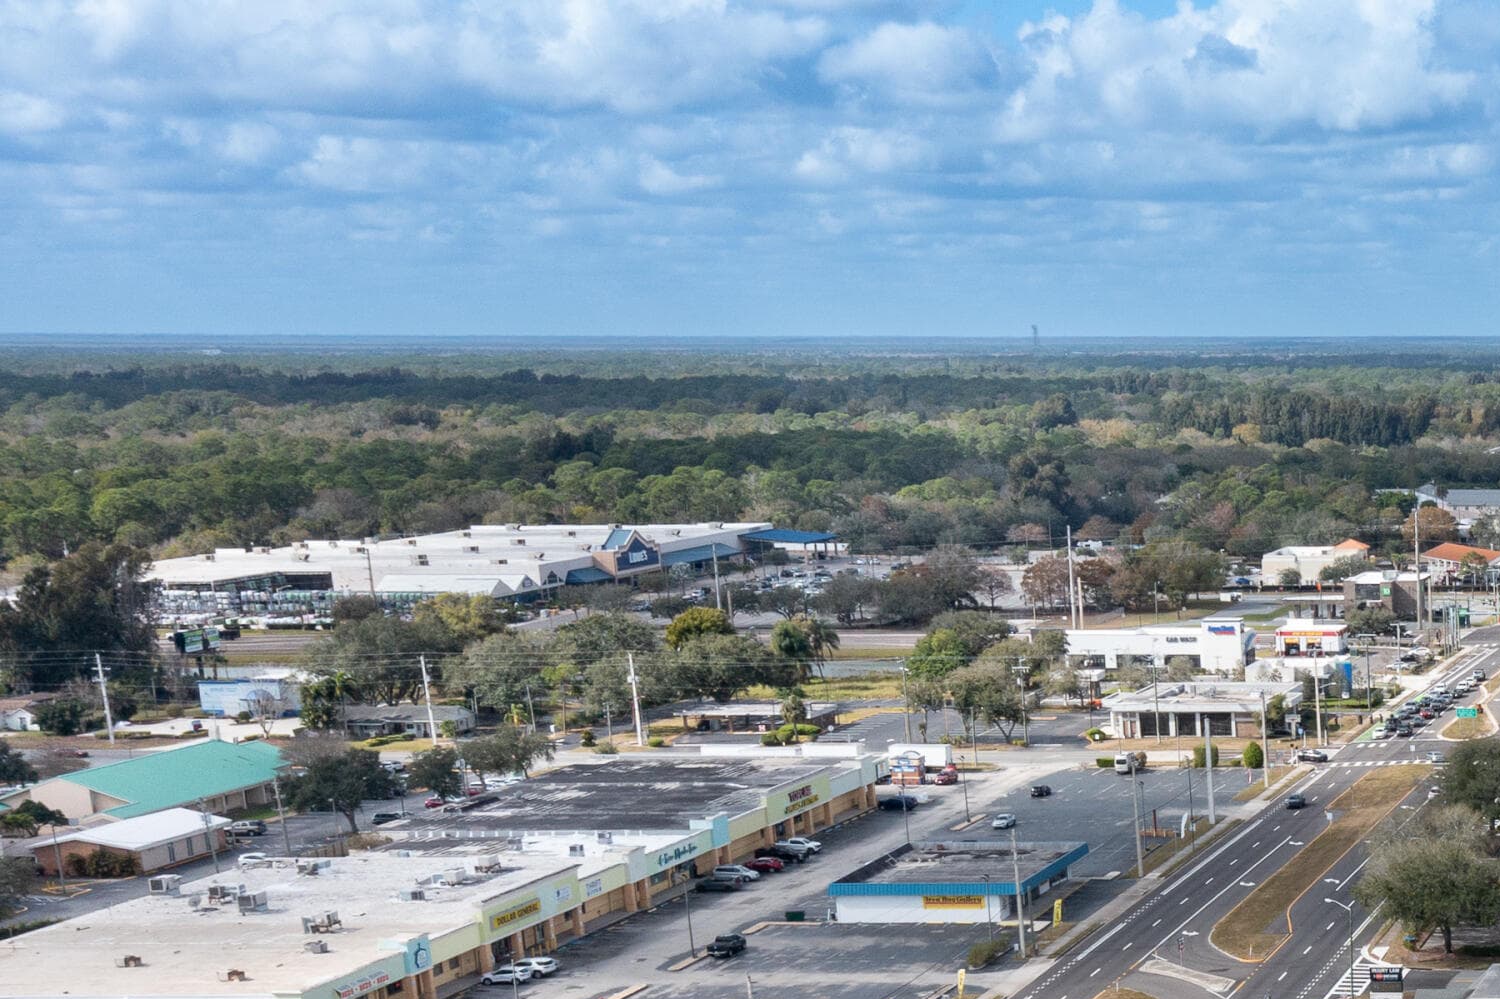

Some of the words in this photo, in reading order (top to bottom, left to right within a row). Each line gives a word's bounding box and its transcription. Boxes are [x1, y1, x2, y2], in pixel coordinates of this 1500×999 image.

[956, 895, 982, 904] Gallery
[496, 912, 517, 926] DOLLAR
[517, 902, 539, 919] GENERAL
